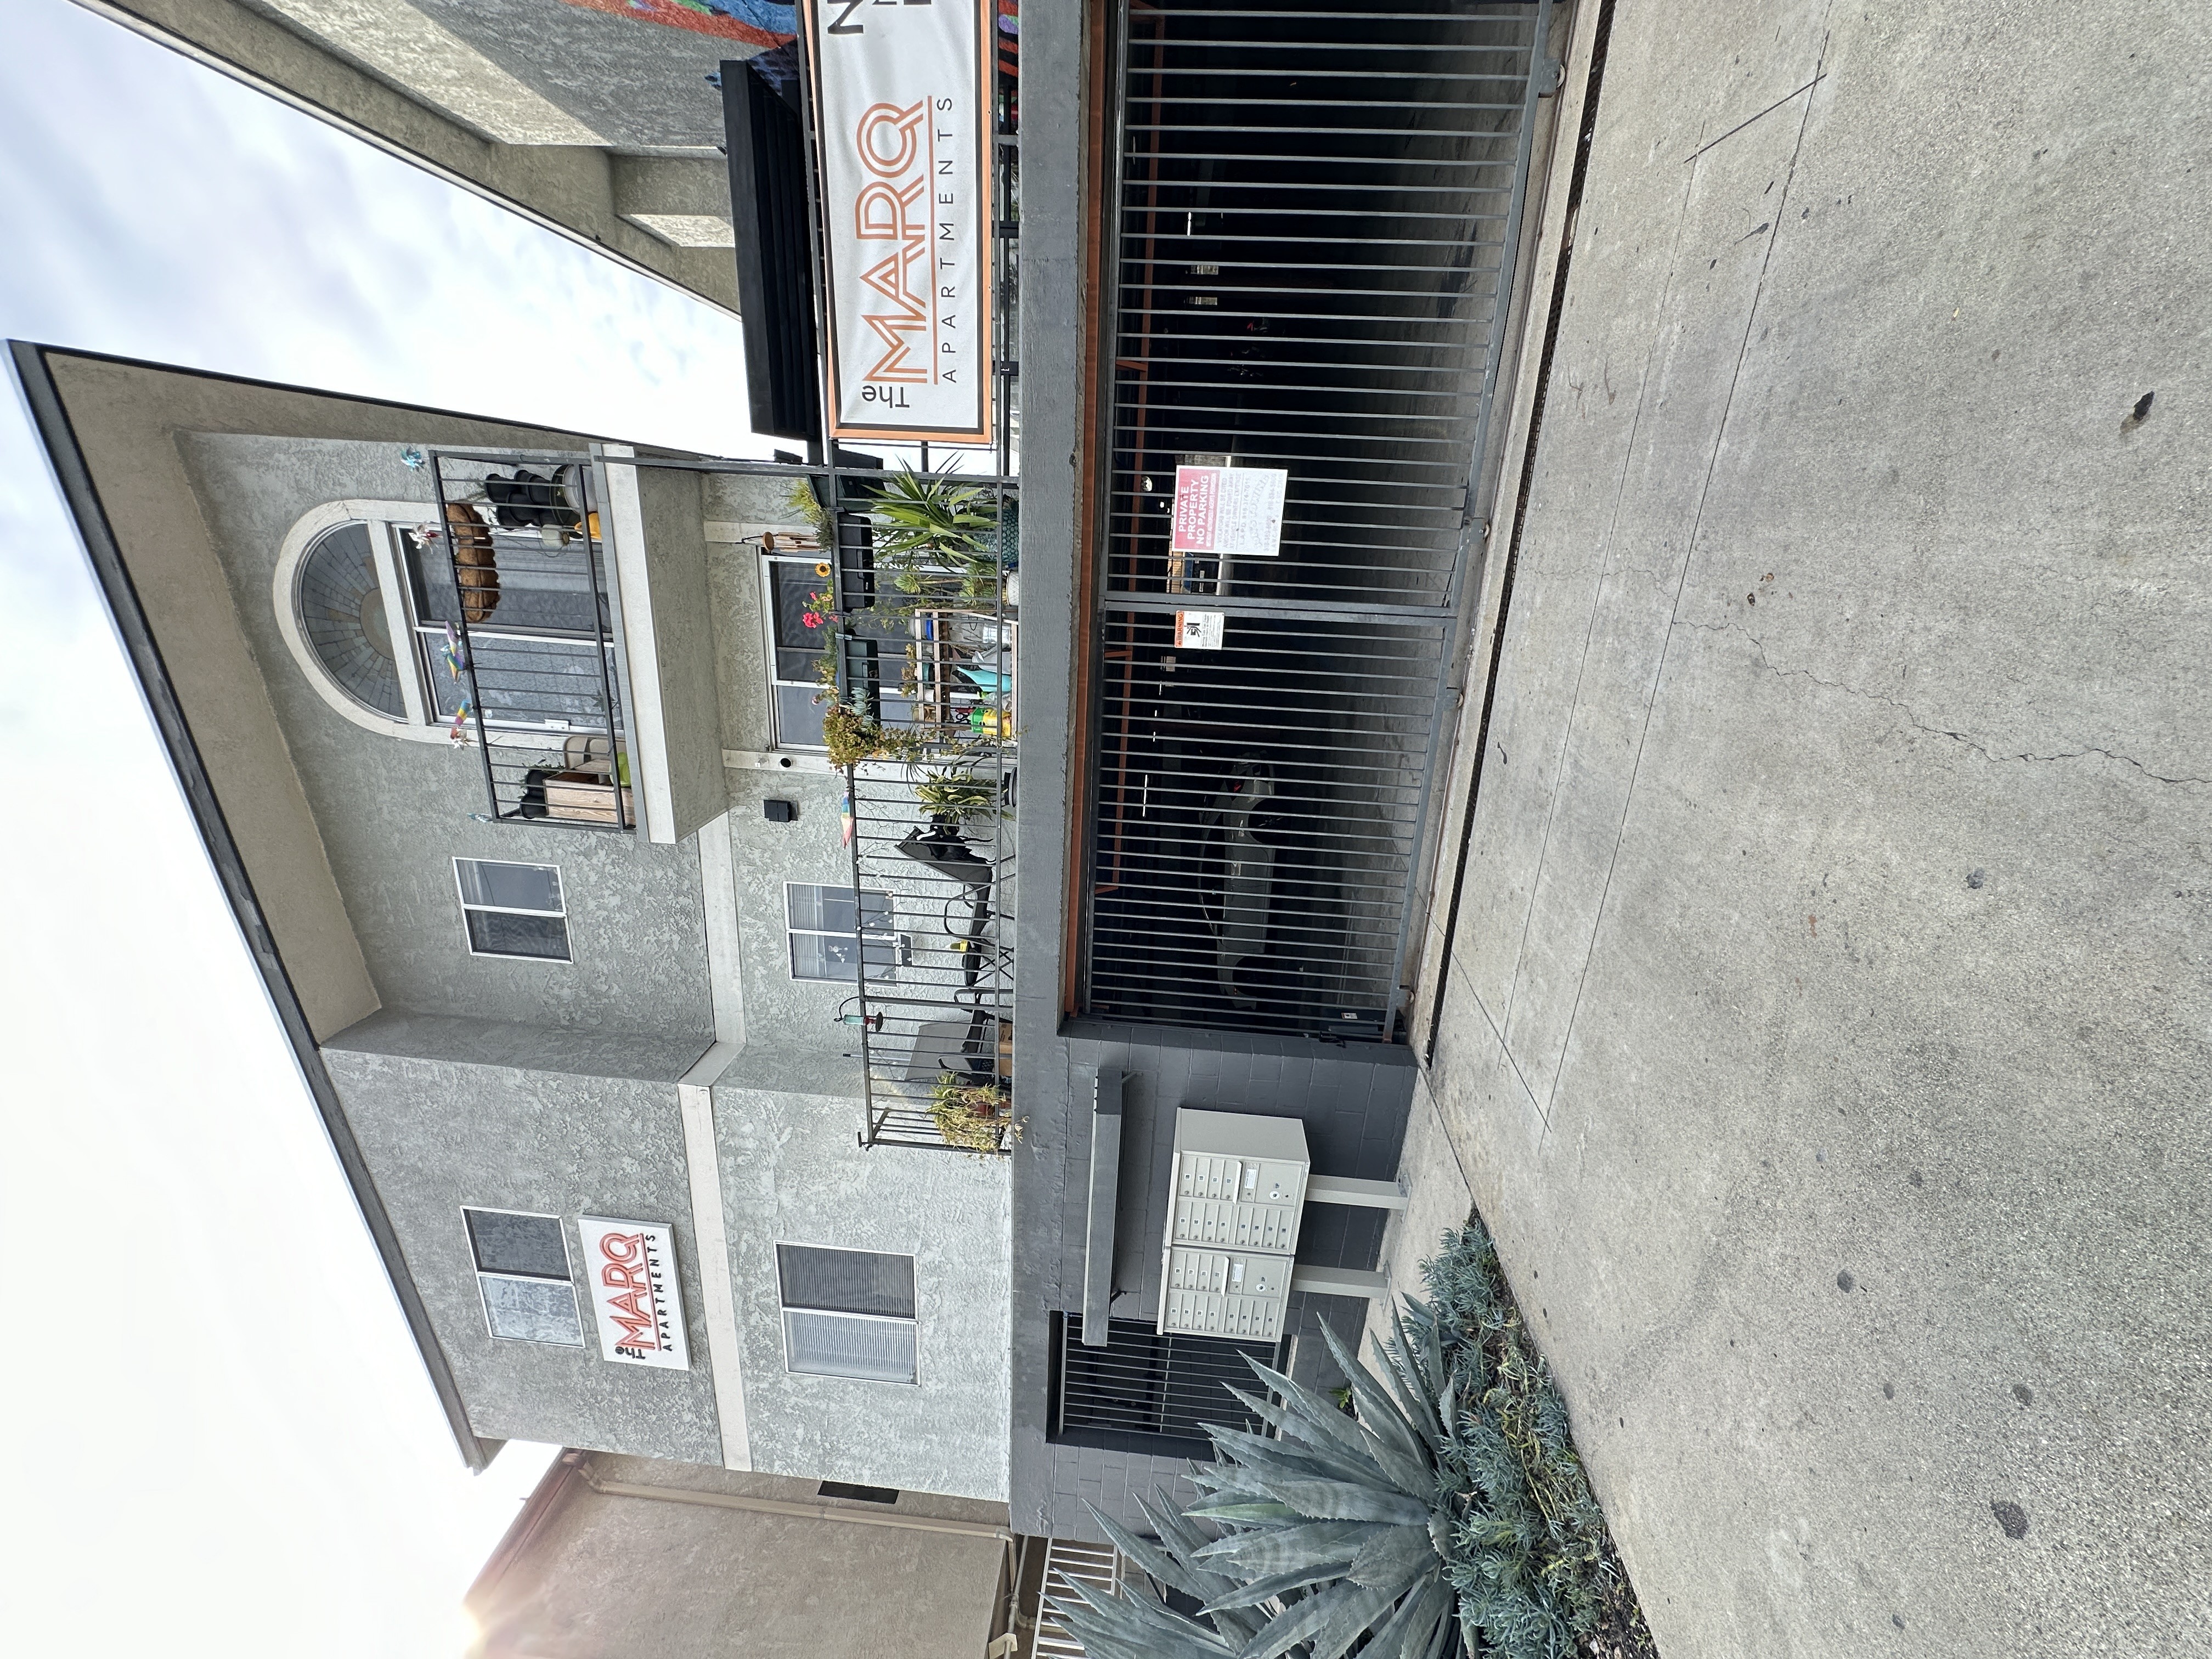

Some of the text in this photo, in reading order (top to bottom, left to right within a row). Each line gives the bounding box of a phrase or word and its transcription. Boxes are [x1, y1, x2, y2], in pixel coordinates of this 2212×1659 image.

[854, 99, 928, 383] MARQ
[936, 97, 957, 383] APARTMENTS
[861, 385, 910, 408] The
[1178, 486, 1189, 532] PRIVATE
[1187, 479, 1199, 539] PROPERTY
[1196, 475, 1209, 544] NO PARKING
[599, 1233, 655, 1350] MARQ
[645, 1234, 672, 1351] APARTMENTS
[614, 1346, 645, 1359] The
